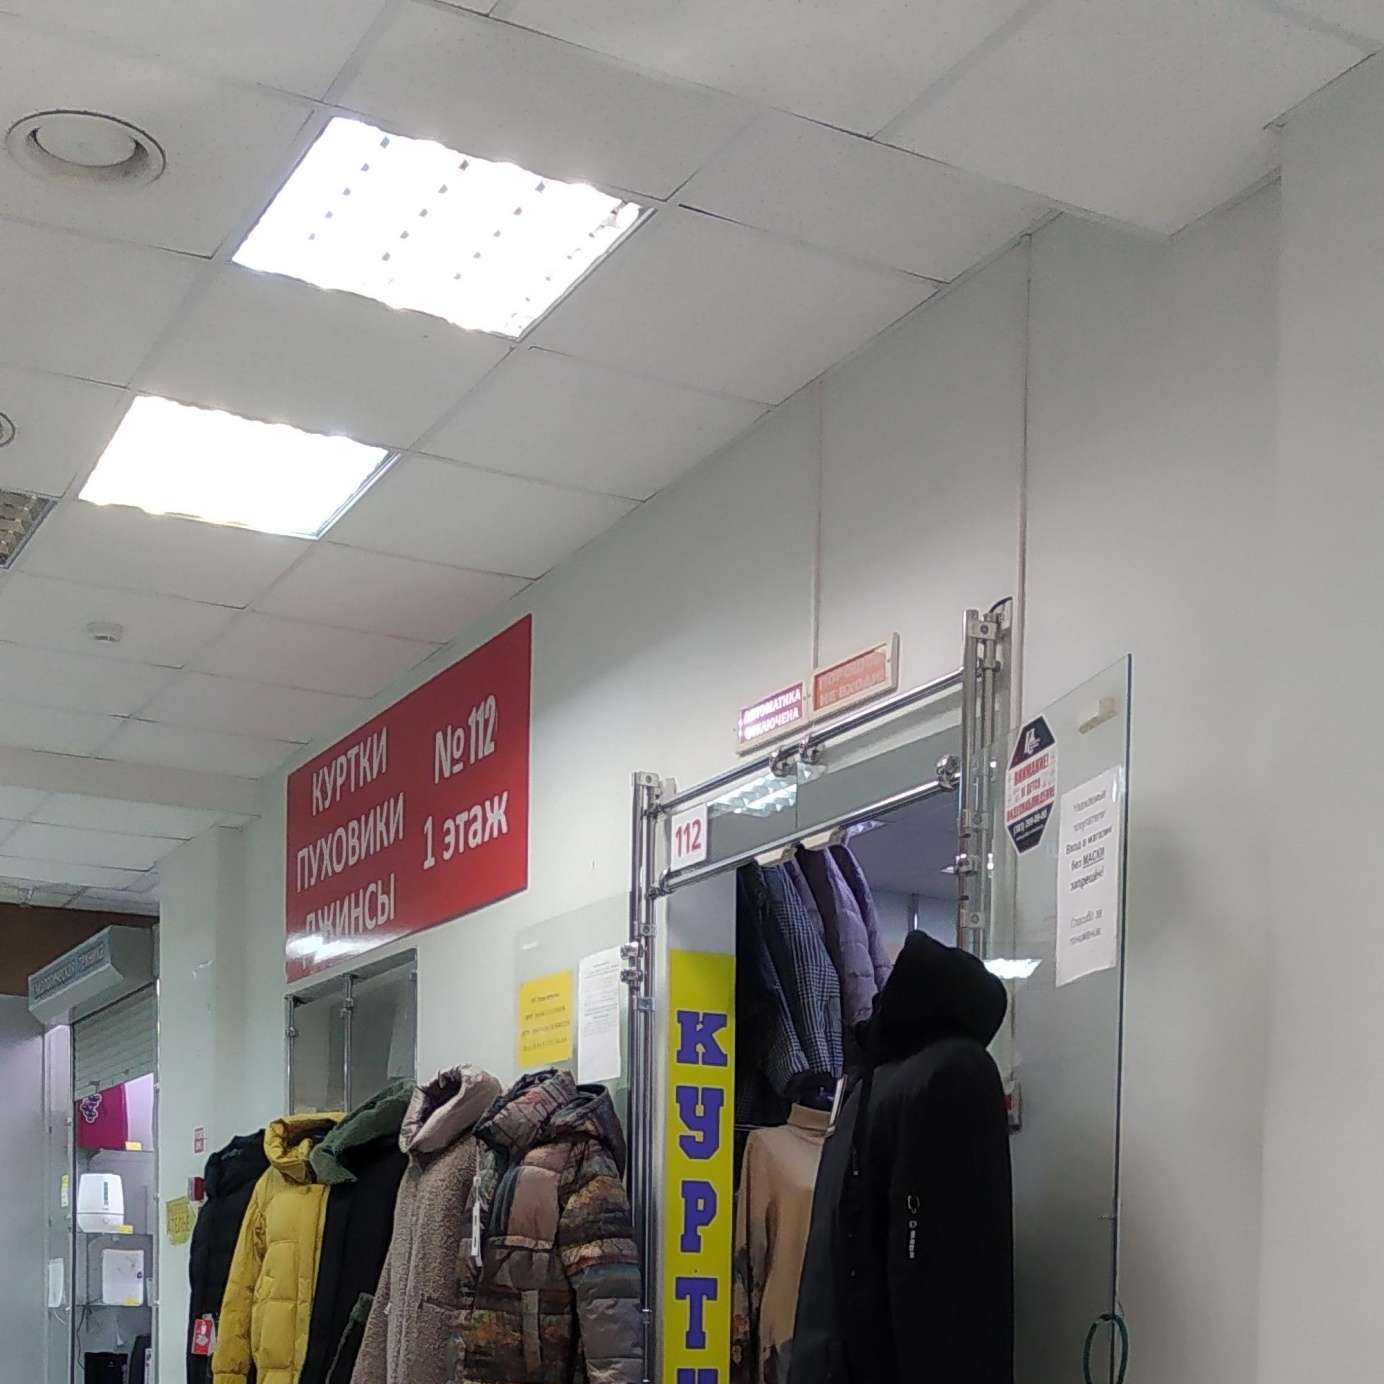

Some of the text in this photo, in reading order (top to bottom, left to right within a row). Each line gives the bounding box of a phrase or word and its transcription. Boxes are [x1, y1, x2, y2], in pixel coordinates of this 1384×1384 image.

[743, 706, 800, 741] ОТКЛЮЧЕНА
[744, 687, 801, 725] АВТОМАТИКА
[311, 727, 387, 816] КУРТКИ
[296, 791, 405, 893] ПУХОВИКИ
[423, 791, 509, 870] 1 этаж
[675, 818, 702, 858] 112
[1065, 840, 1082, 856] Вход
[1071, 847, 1105, 872] без МАСКИ
